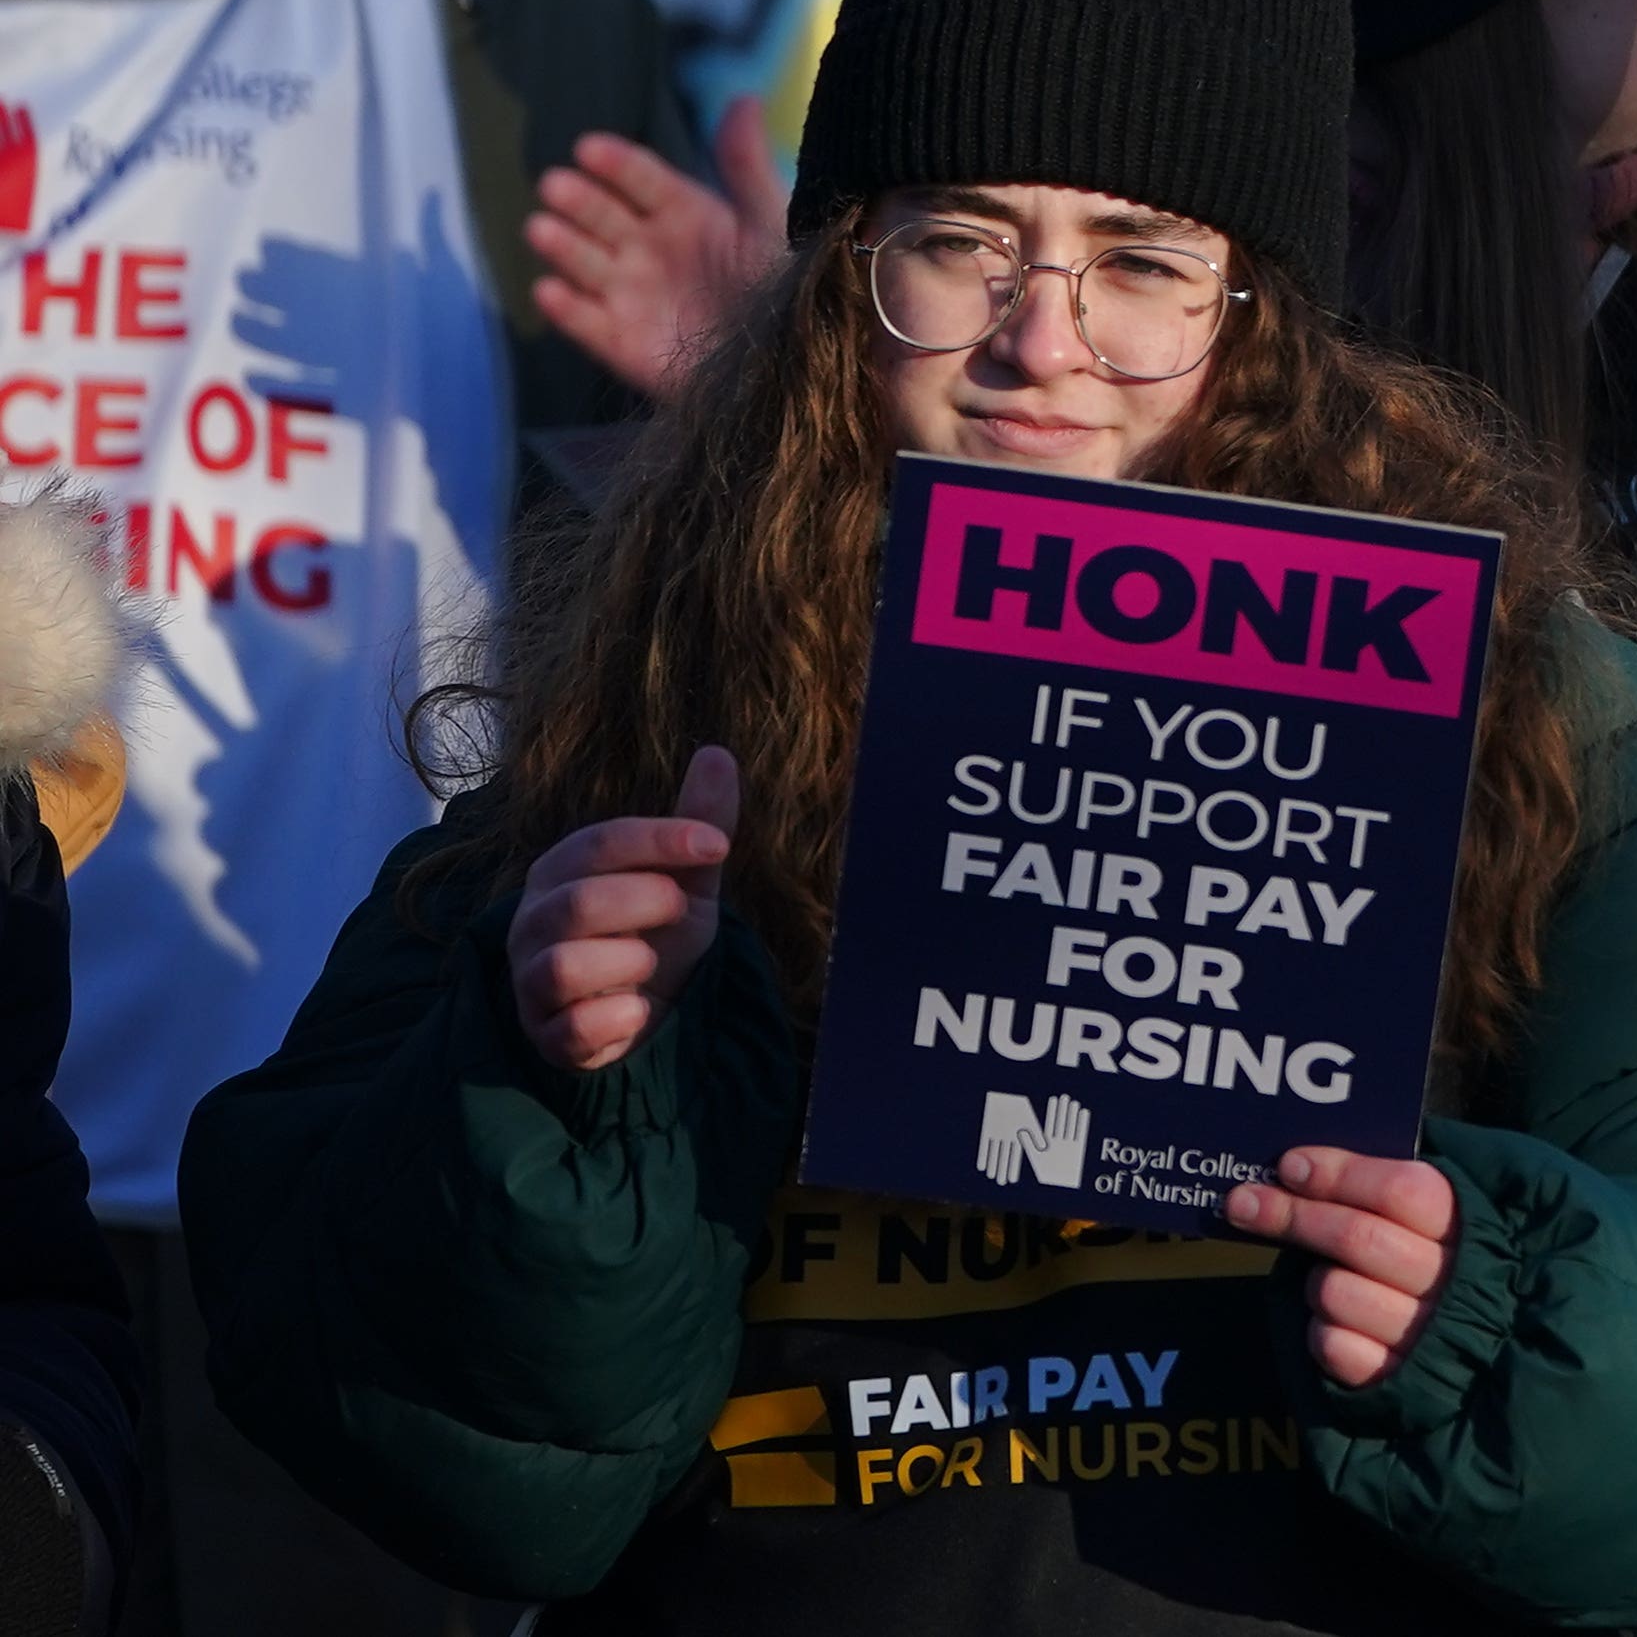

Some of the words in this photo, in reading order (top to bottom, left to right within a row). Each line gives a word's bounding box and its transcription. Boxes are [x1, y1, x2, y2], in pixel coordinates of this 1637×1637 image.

[20, 245, 190, 344] HE
[186, 381, 336, 483] OF
[953, 524, 1442, 684] HONK
[1031, 684, 1110, 748] IF
[1133, 698, 1327, 781] YOU
[946, 754, 1391, 869] SUPPORT
[941, 832, 1163, 920] FAIR
[1184, 865, 1375, 946] PAY
[1046, 926, 1244, 1011] FOR
[913, 987, 1355, 1104] NURSING
[1094, 1170, 1129, 1195] of
[1130, 1174, 1226, 1219] Nursin
[1099, 1137, 1176, 1174] Royal
[848, 1365, 1009, 1437] FAIR
[1027, 1350, 1180, 1414] PAY
[858, 1438, 983, 1505] FOR
[1009, 1417, 1302, 1484] NURSIN
